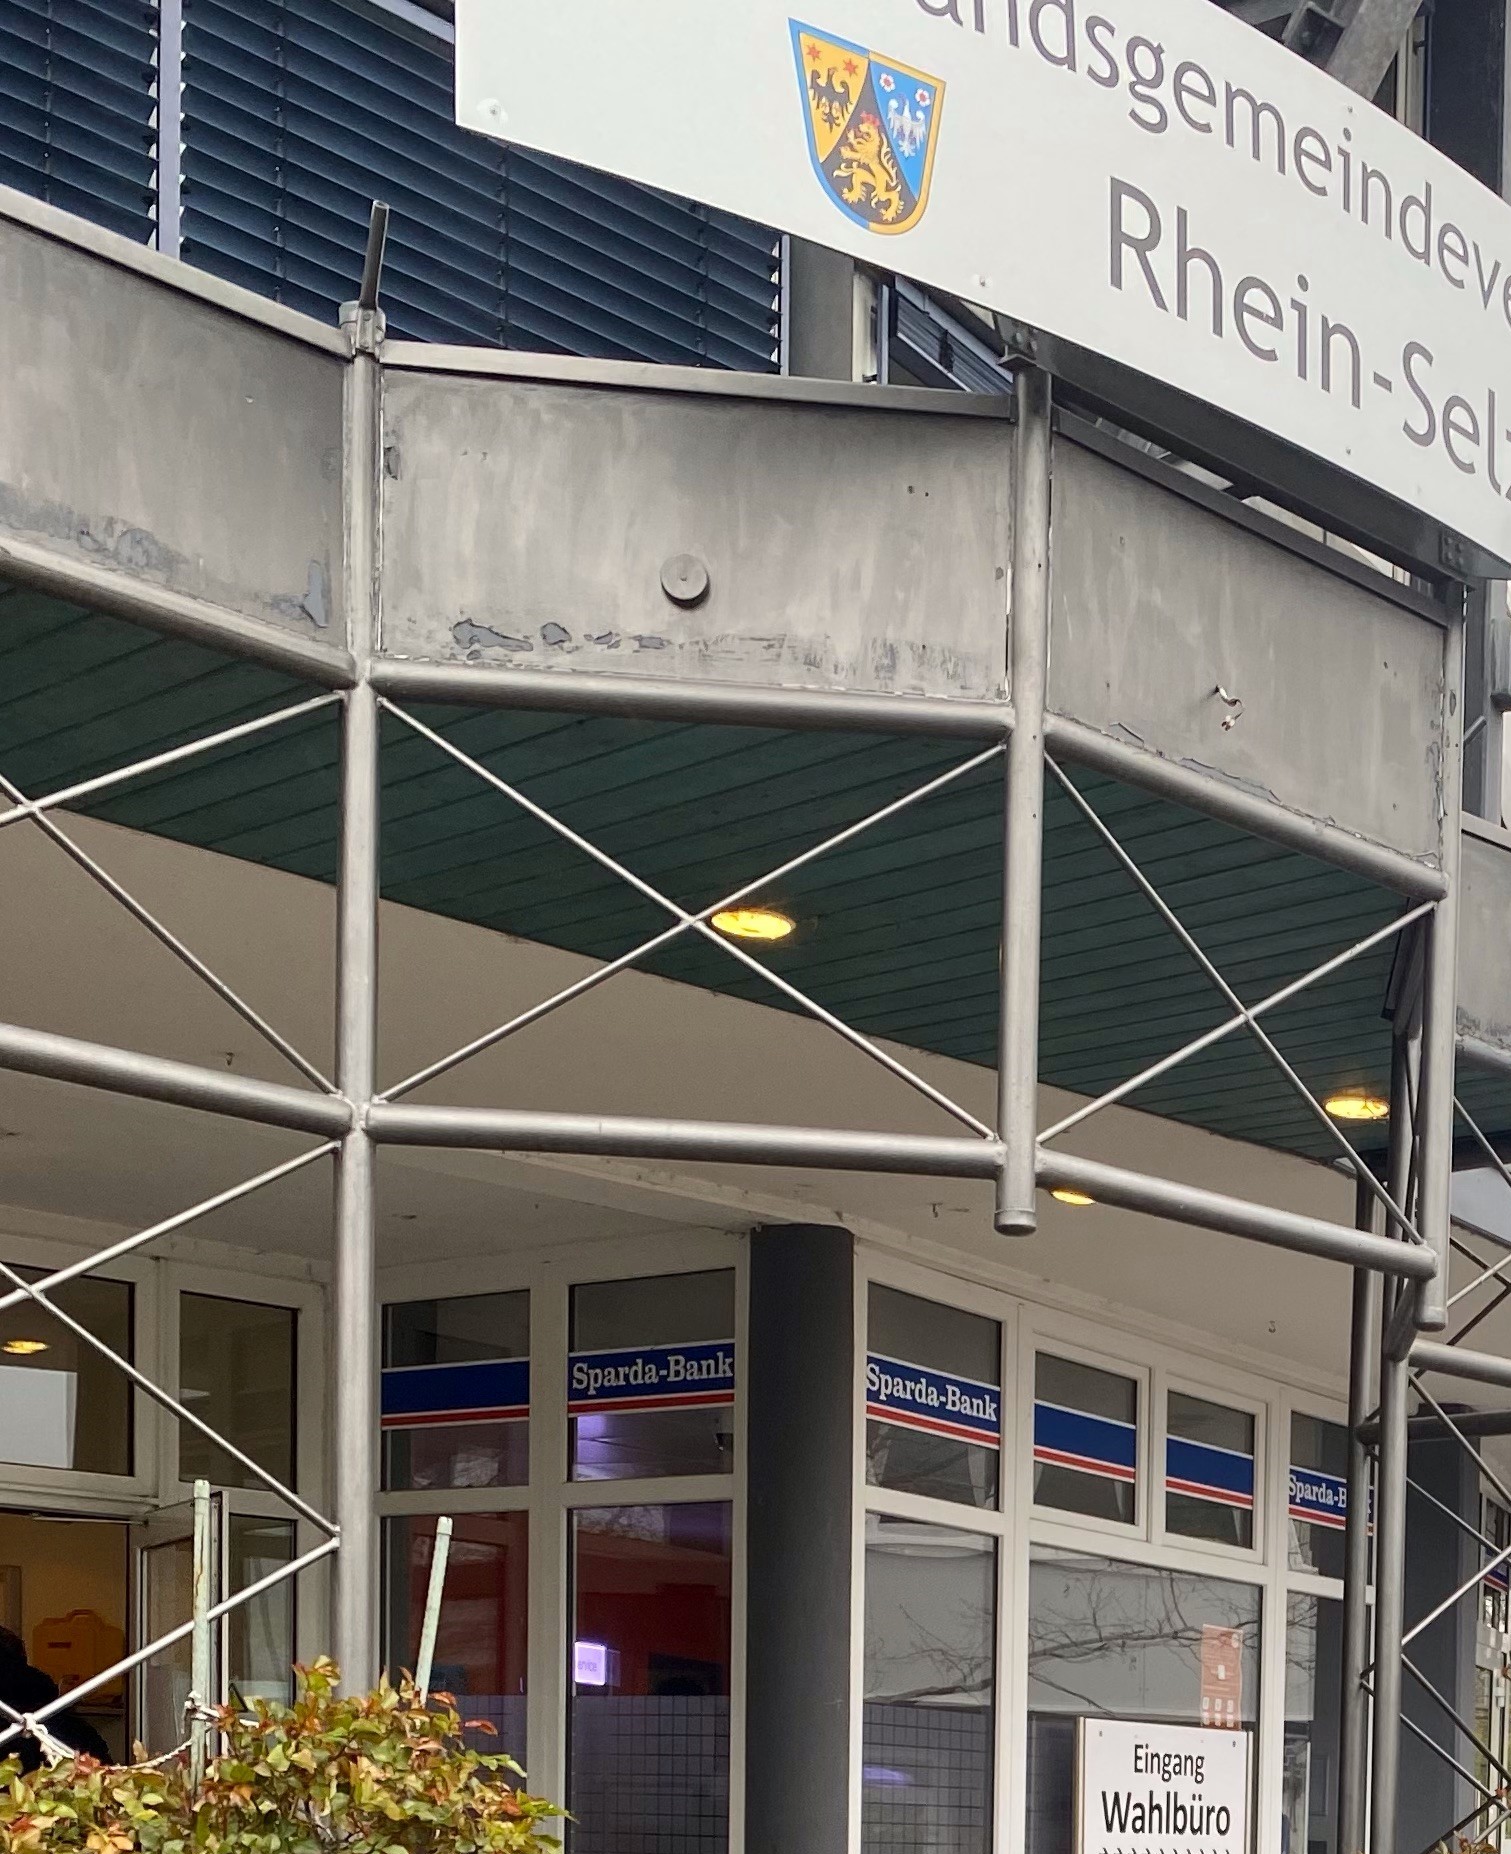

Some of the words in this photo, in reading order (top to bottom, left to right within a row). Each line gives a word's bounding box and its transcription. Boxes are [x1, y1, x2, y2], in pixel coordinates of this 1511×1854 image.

[572, 1352, 734, 1394] Sparda-Bank
[866, 1363, 997, 1422] Sparda-Bank
[1133, 1743, 1205, 1785] Eingang
[1101, 1790, 1231, 1837] Wahlbüro
